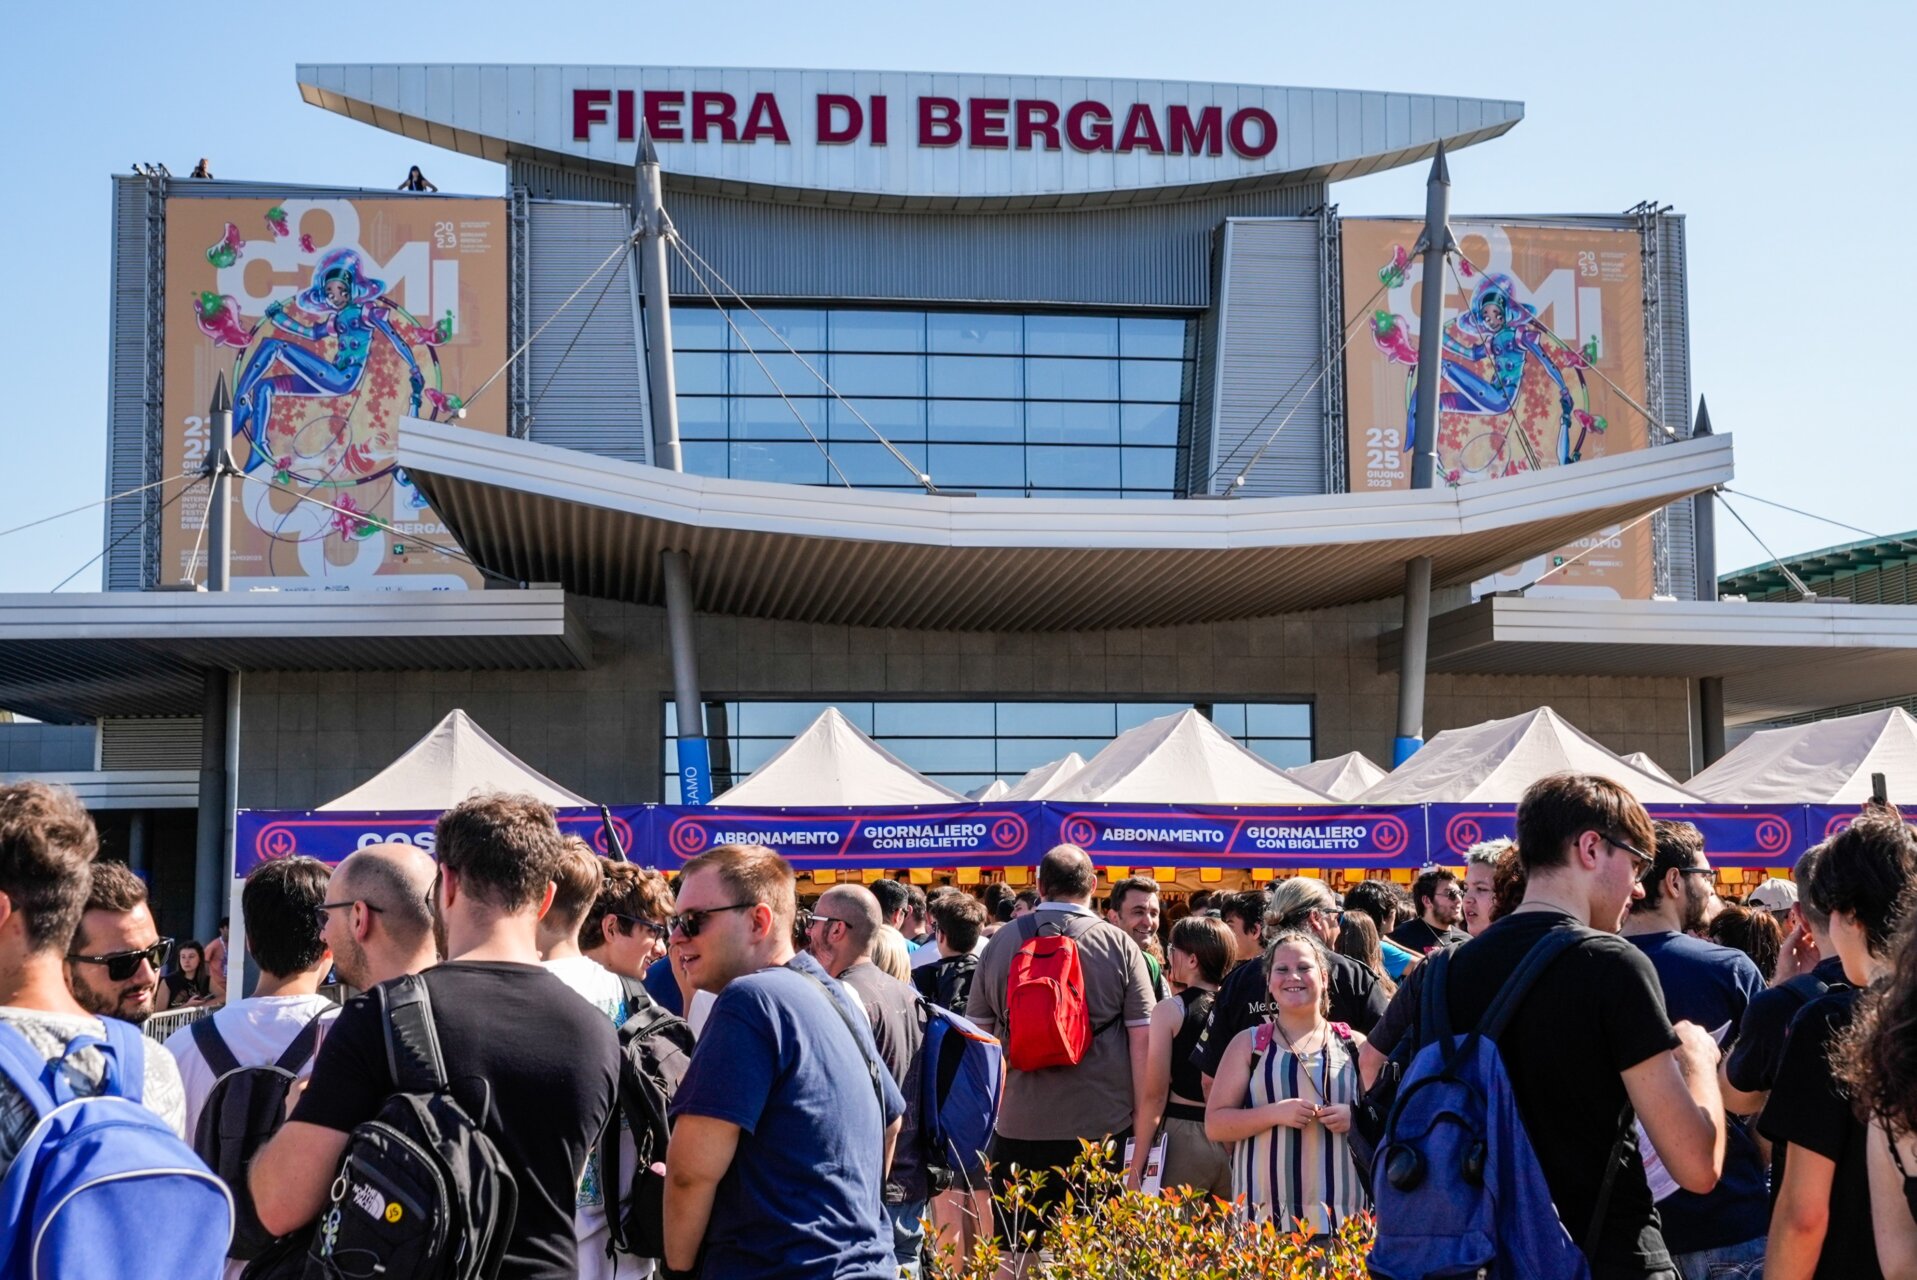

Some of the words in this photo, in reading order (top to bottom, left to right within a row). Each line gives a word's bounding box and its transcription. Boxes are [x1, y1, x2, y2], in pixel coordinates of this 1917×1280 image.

[573, 89, 791, 145] FIERA
[816, 93, 887, 147] DI
[917, 96, 1278, 160] BERGAMO
[1366, 427, 1400, 449] 23
[1367, 449, 1400, 470] 25
[1367, 470, 1405, 480] GIUGNO
[1367, 479, 1392, 487] 2023
[394, 522, 450, 535] BERGA
[713, 831, 840, 846] ABBONAMENTO
[864, 823, 987, 839] GIORNALIERO
[1102, 828, 1225, 843] ABBONAMENTO
[1246, 826, 1367, 839] GIORNALIERO
[357, 831, 437, 855] COS
[873, 838, 903, 849] CON
[905, 836, 979, 849] BIGLIETTO
[1256, 838, 1286, 849] CON
[1288, 838, 1359, 849] BIGLIETTO
